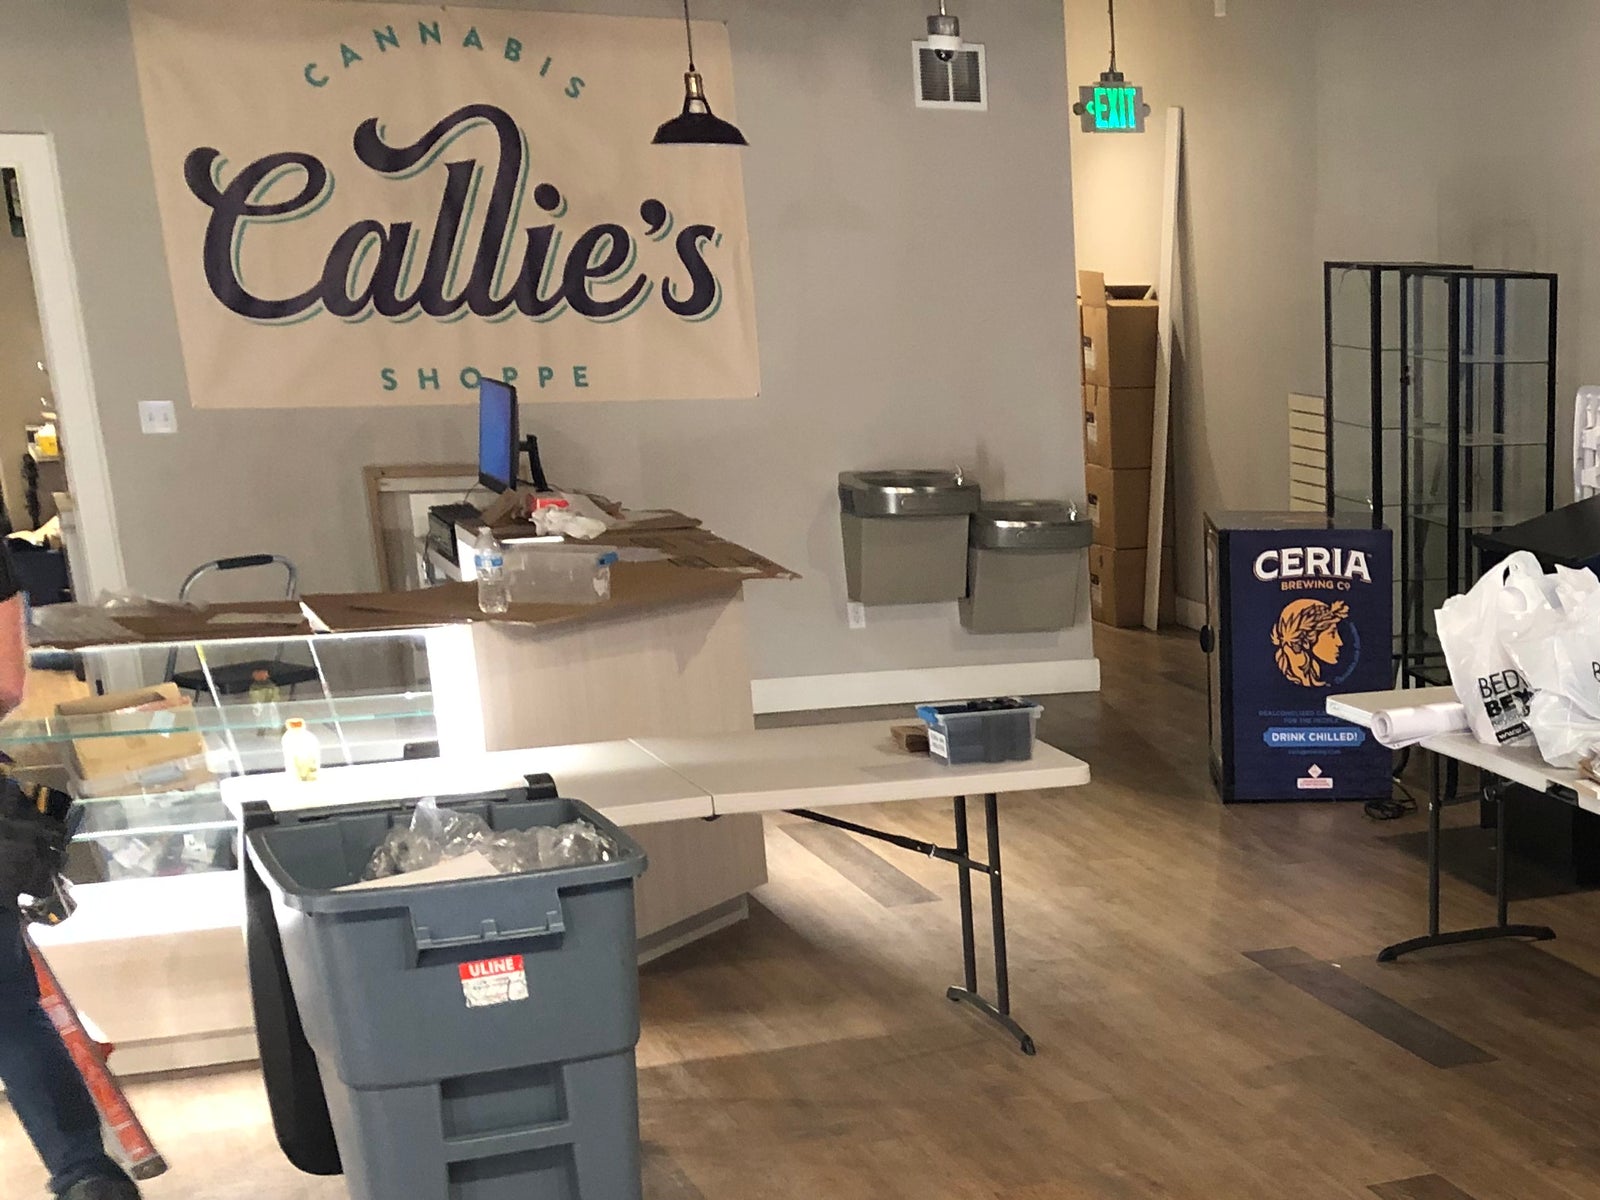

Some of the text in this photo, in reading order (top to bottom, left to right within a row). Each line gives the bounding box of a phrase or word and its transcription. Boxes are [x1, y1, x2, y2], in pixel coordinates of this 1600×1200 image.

[304, 21, 586, 98] CANNABIS
[1094, 87, 1136, 129] EXIT
[184, 104, 723, 324] Callie's
[381, 366, 589, 391] SHOPPE
[1252, 546, 1372, 583] CERIA
[1281, 580, 1334, 591] BREWING
[1478, 669, 1520, 699] BED
[1271, 731, 1358, 742] DRINK CHILLED!
[468, 957, 514, 977] ULINE
